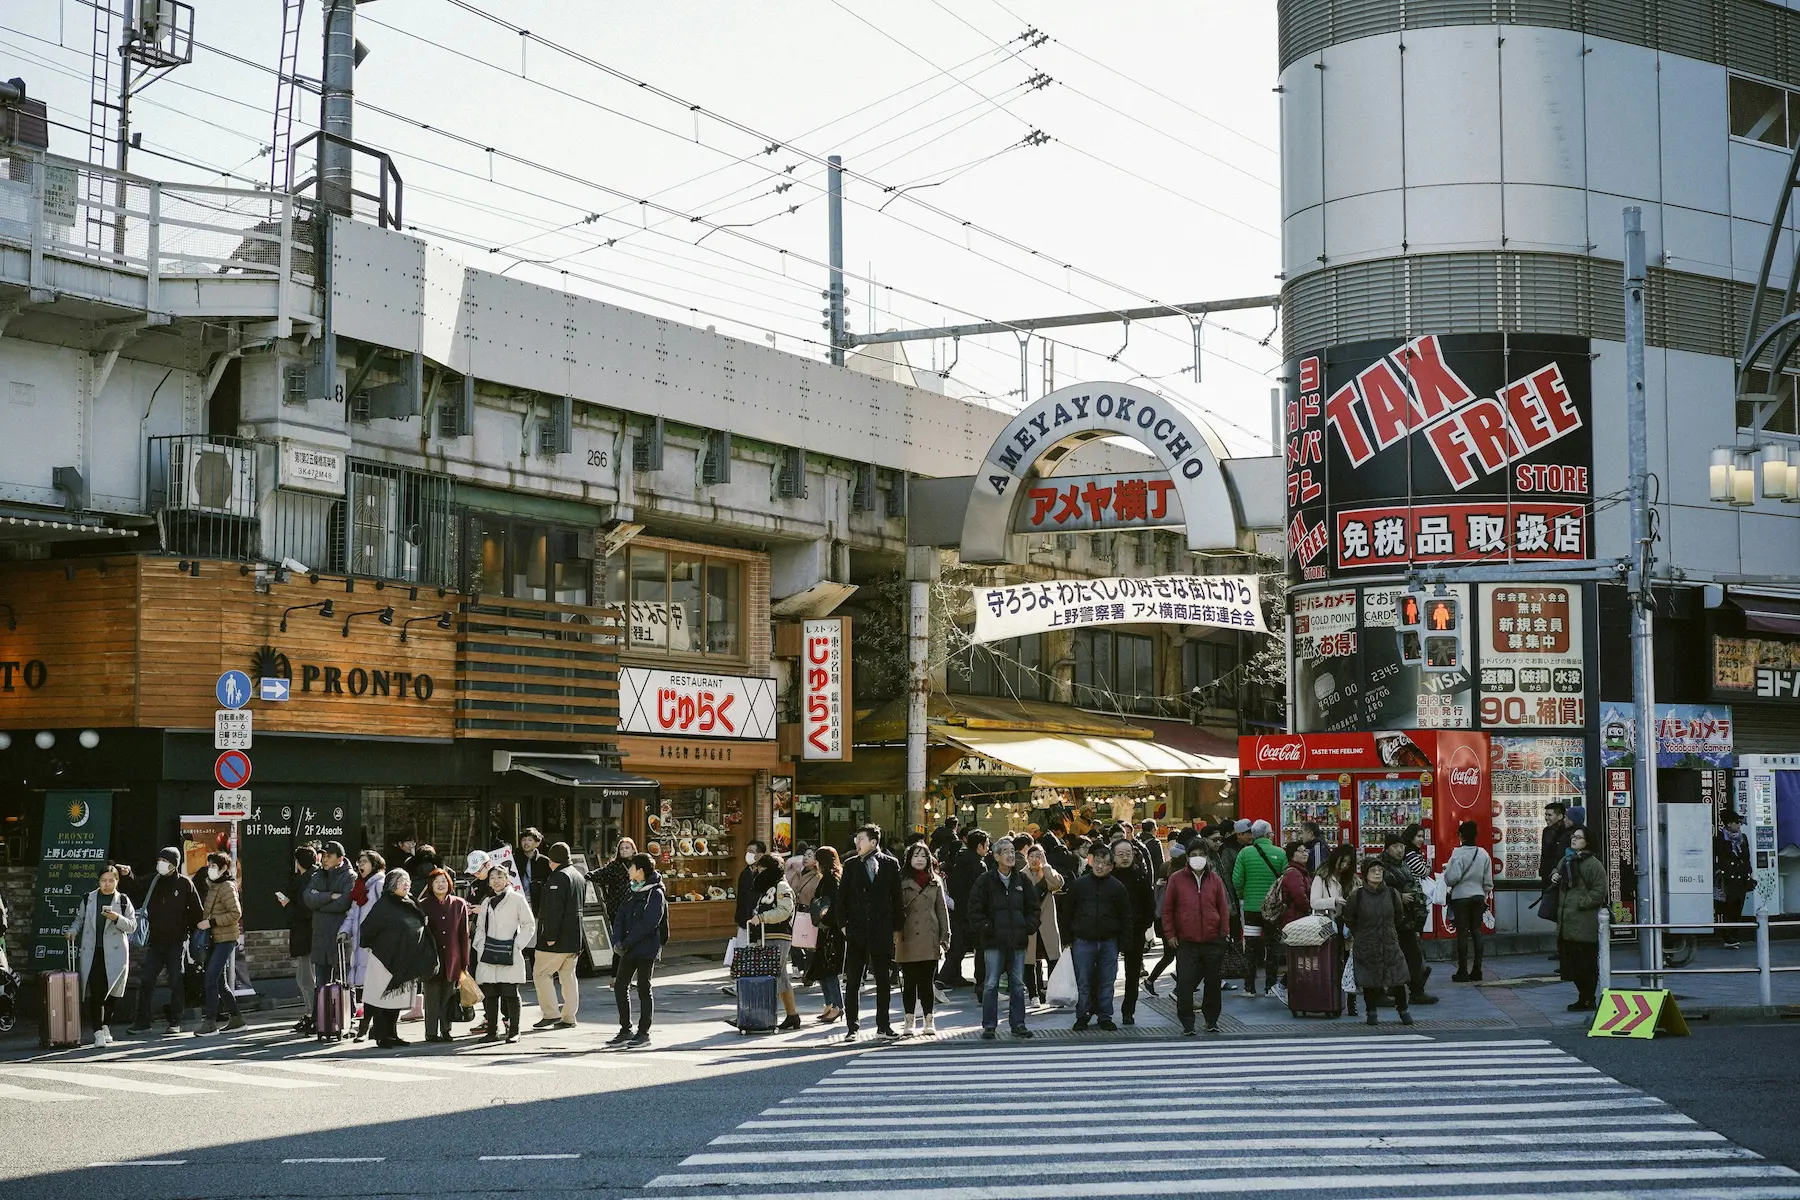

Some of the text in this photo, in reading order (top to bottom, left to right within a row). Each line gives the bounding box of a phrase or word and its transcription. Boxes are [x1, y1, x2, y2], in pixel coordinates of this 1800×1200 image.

[1327, 335, 1583, 492] TAX FREE
[1300, 356, 1322, 504] ヨドバシ
[989, 394, 1204, 496] AMEYAYOKOCHO
[1287, 400, 1300, 507] カメラ
[587, 449, 608, 468] 266
[1516, 464, 1588, 494] STORE
[1028, 479, 1176, 526] アメヤ横丁
[1287, 510, 1328, 569] TAX FREE
[1342, 514, 1581, 558] 免税品取扱店
[1304, 564, 1326, 580] STORE
[1295, 593, 1356, 612] ヨドバシカメラ
[1496, 592, 1566, 602] 年会費・入会金
[1048, 602, 1256, 627] 上野警察署 アメ横商店街連合会
[1518, 603, 1542, 614] 無料
[1311, 615, 1329, 626] GOLD
[1331, 612, 1356, 623] POINT
[1499, 618, 1562, 632] 新規会員
[806, 625, 840, 634] レストラン
[1508, 634, 1555, 649] 募集中
[670, 675, 723, 689] RESTAURANT
[1371, 663, 1399, 682] 2345
[1481, 669, 1514, 684] 盗難
[1520, 669, 1549, 684] 破損
[1555, 670, 1580, 684] 水没
[302, 664, 434, 701] PRONTO
[1421, 672, 1466, 693] VISA
[808, 636, 830, 753] じゅらく
[1417, 694, 1452, 706] 店内で
[657, 687, 735, 734] じゅらく
[1417, 706, 1463, 717] 即時発行
[1259, 743, 1301, 762] Coca-Cola
[1451, 767, 1480, 786] Coca-Cola
[58, 832, 94, 840] PRONTO
[247, 824, 291, 835] B1F 19seats
[305, 825, 343, 835] 2F 24seats
[44, 848, 105, 859] 上野しのばず口店
[1613, 901, 1633, 922] 5%
